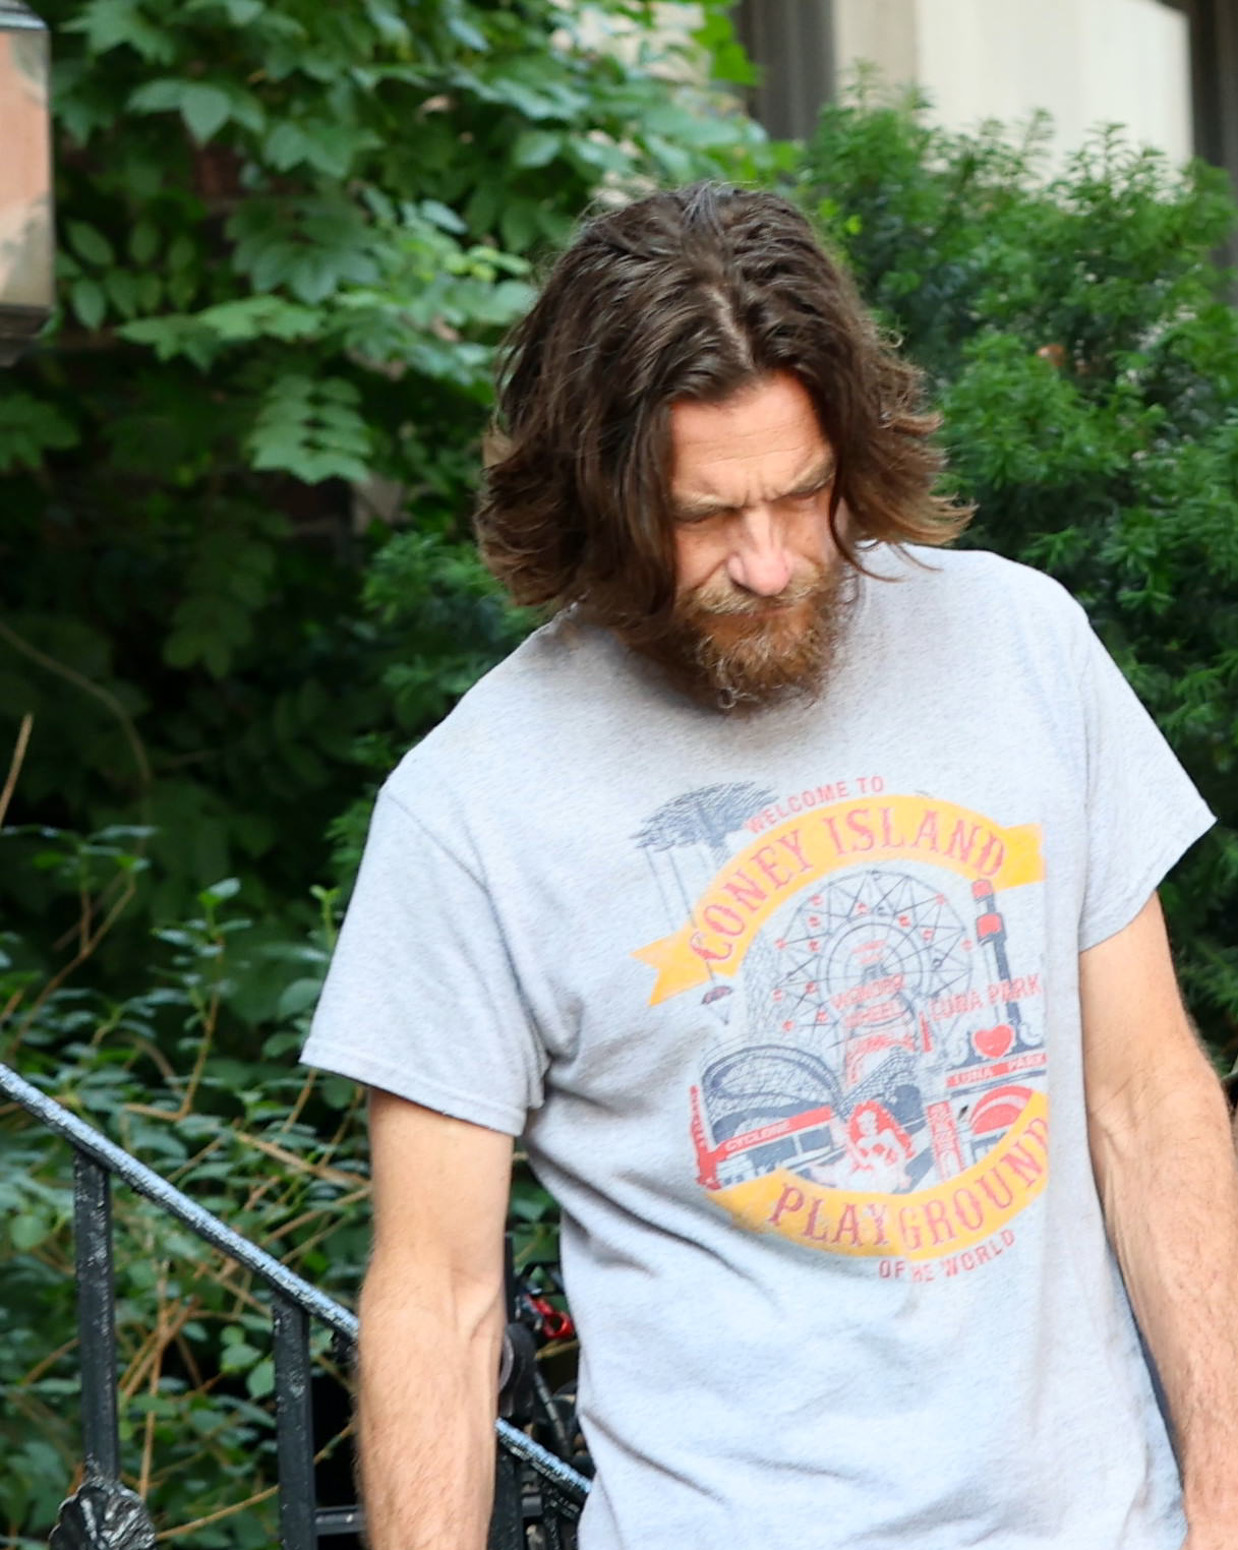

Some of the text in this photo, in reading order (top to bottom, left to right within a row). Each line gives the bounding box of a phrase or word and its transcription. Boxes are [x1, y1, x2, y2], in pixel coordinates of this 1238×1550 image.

[744, 776, 884, 834] WELCOME TO
[690, 807, 1004, 961] CONEY ISLAND
[988, 973, 1043, 1004] PARK
[769, 1117, 1048, 1250] PLAYGROUND
[879, 1260, 905, 1279] OF
[941, 1229, 1017, 1277] WORLD
